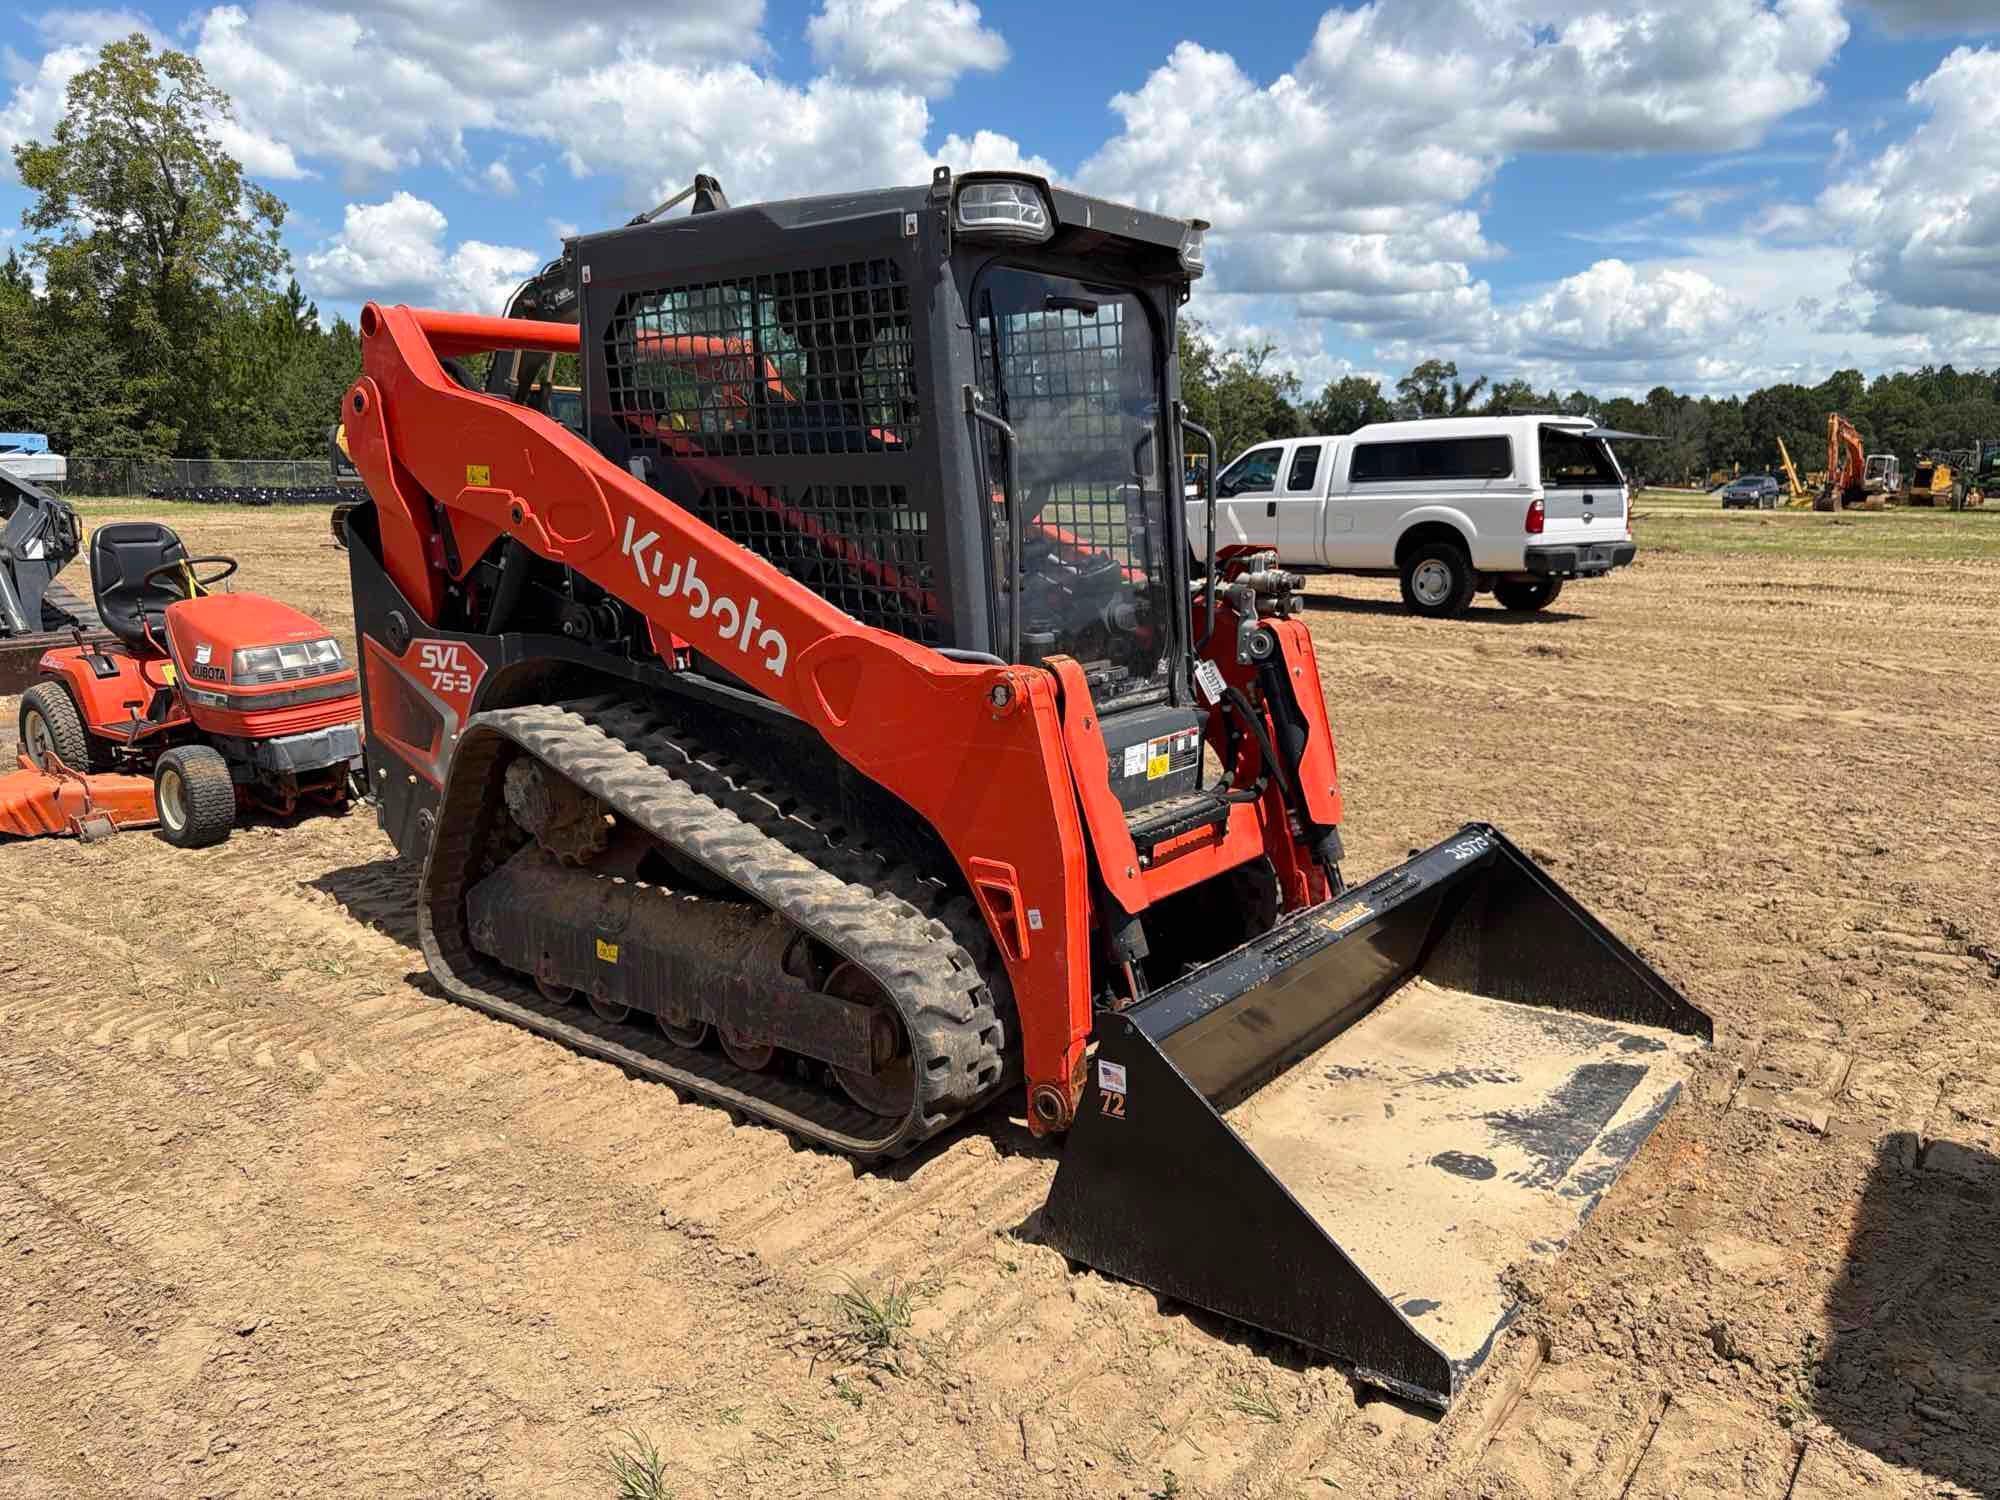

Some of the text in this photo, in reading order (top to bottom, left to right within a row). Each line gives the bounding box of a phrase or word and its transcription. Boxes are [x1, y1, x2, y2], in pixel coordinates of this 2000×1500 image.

[622, 515, 788, 678] Kubota
[419, 645, 467, 671] SVL
[192, 664, 226, 681] KUBOTA
[431, 671, 472, 693] 75-3
[1100, 1090, 1125, 1116] 72
